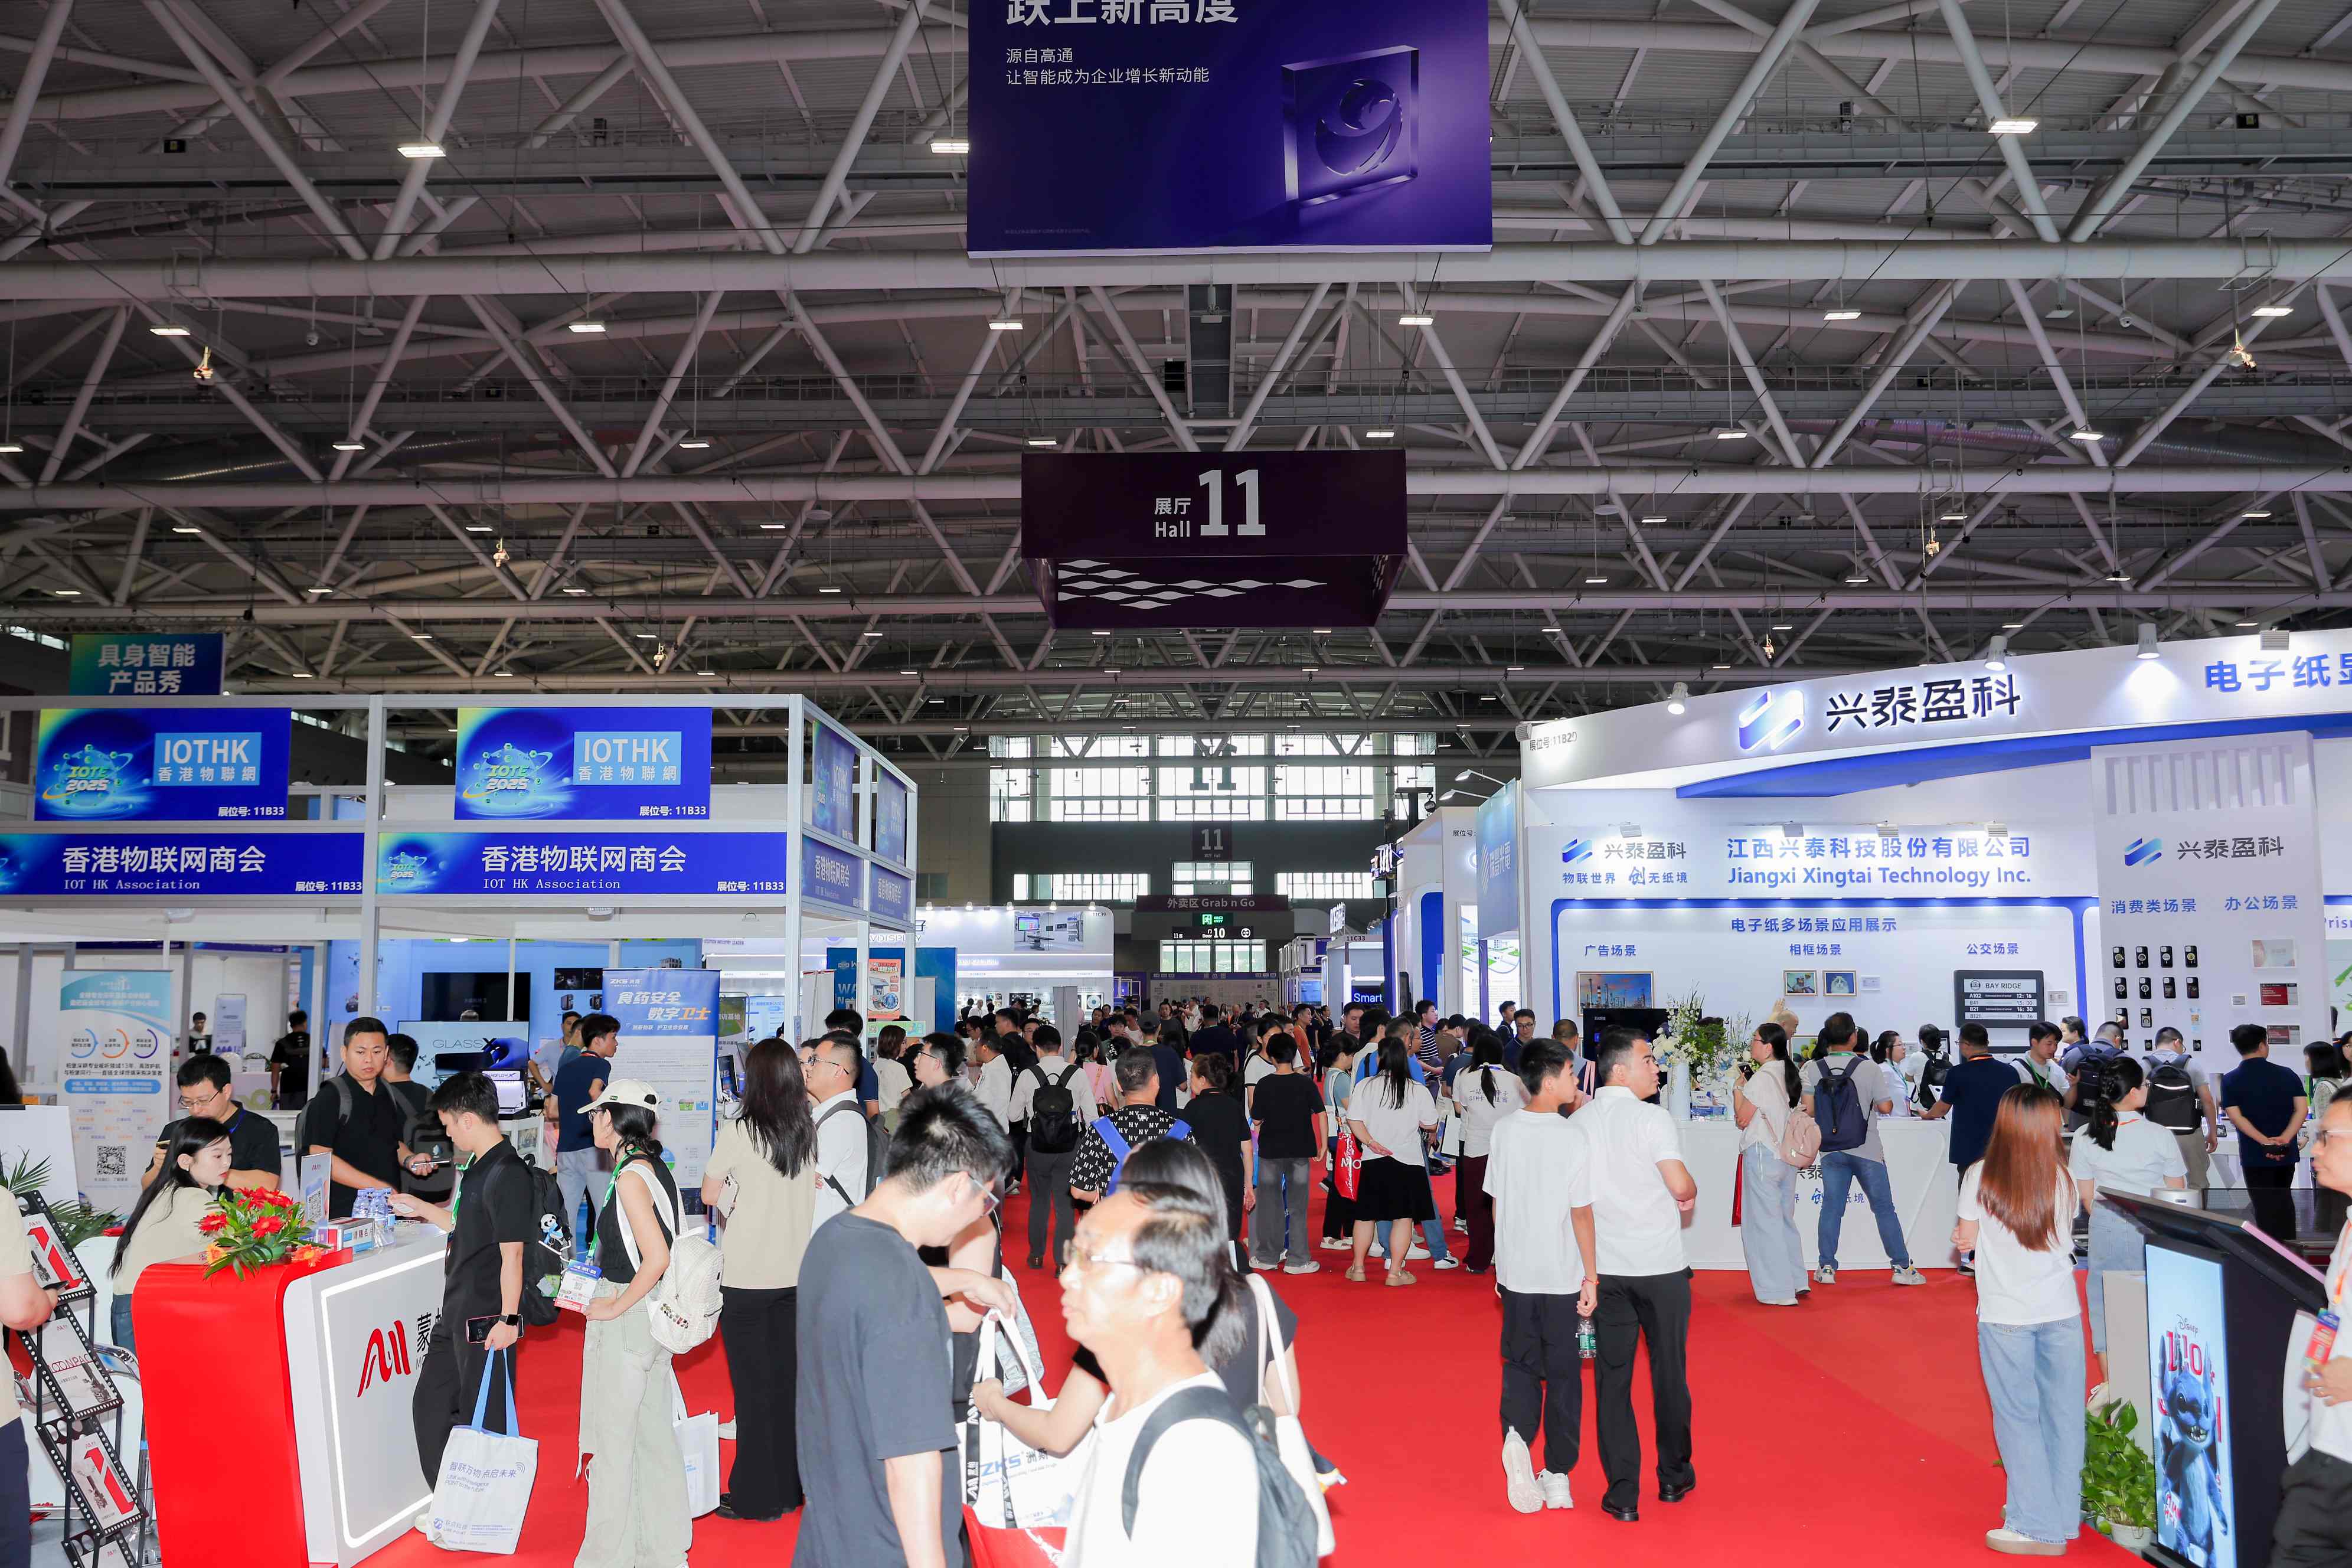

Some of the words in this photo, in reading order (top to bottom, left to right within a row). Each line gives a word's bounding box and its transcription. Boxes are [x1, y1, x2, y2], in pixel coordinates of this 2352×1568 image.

[1006, 47, 1073, 64] 源自高通
[1006, 68, 1210, 86] 让智能成为企业增长新动能
[1154, 498, 1191, 515] 展厅
[1198, 469, 1266, 536] 11
[1155, 521, 1190, 538] Hall
[98, 643, 195, 668] 具身智能
[109, 670, 182, 694] 产品秀
[1827, 674, 2020, 732] 兴泰盈科
[164, 739, 250, 763] IOTHK
[584, 737, 669, 763] IOTHK
[68, 766, 107, 779] IOTE
[158, 766, 256, 782] 香港物聯網
[488, 765, 529, 778] IOTE
[578, 766, 677, 782] 香港物聯網
[66, 778, 109, 792] 2025
[486, 778, 528, 791] 2025
[253, 806, 285, 816] 11B33
[675, 806, 706, 816] 11B33
[1201, 829, 1223, 850] 11
[1727, 836, 2031, 859] 江西兴泰科技股份有限公司
[1604, 842, 1687, 861] 兴泰盈科
[2177, 836, 2284, 860] 兴泰盈科
[62, 845, 266, 874] 香港物联网商会
[481, 845, 687, 873] 香港物联网商会
[1563, 872, 1616, 884] 物联世界
[1628, 865, 1688, 886] 创无纸境
[1728, 867, 1796, 888] Jiangxi
[1802, 866, 1872, 888] Xingtai
[1881, 865, 1991, 888] Technology
[1997, 867, 2031, 884] Inc.
[64, 880, 87, 889] IOT
[93, 880, 109, 889] HK
[116, 880, 200, 890] Association
[331, 881, 362, 891] 11B33
[483, 880, 505, 889] IOT
[513, 880, 529, 889] HK
[536, 879, 620, 889] Association
[753, 881, 785, 891] 11B33
[1167, 898, 1199, 909] 外卖区
[1202, 899, 1227, 907] Grab
[1240, 899, 1255, 907] Go
[2111, 898, 2197, 914] 消费类场景
[2224, 895, 2298, 911] 办公场景
[1213, 927, 1226, 938] 10
[1731, 917, 1897, 933] 电子纸多场景应用展示
[1584, 944, 1636, 957] 广告场景
[1789, 943, 1842, 956] 相框场景
[1966, 943, 2019, 956] 公交场景
[618, 991, 681, 1004] 食药安全
[1354, 993, 1383, 1002] Smart
[646, 1007, 712, 1020] 数字卫士
